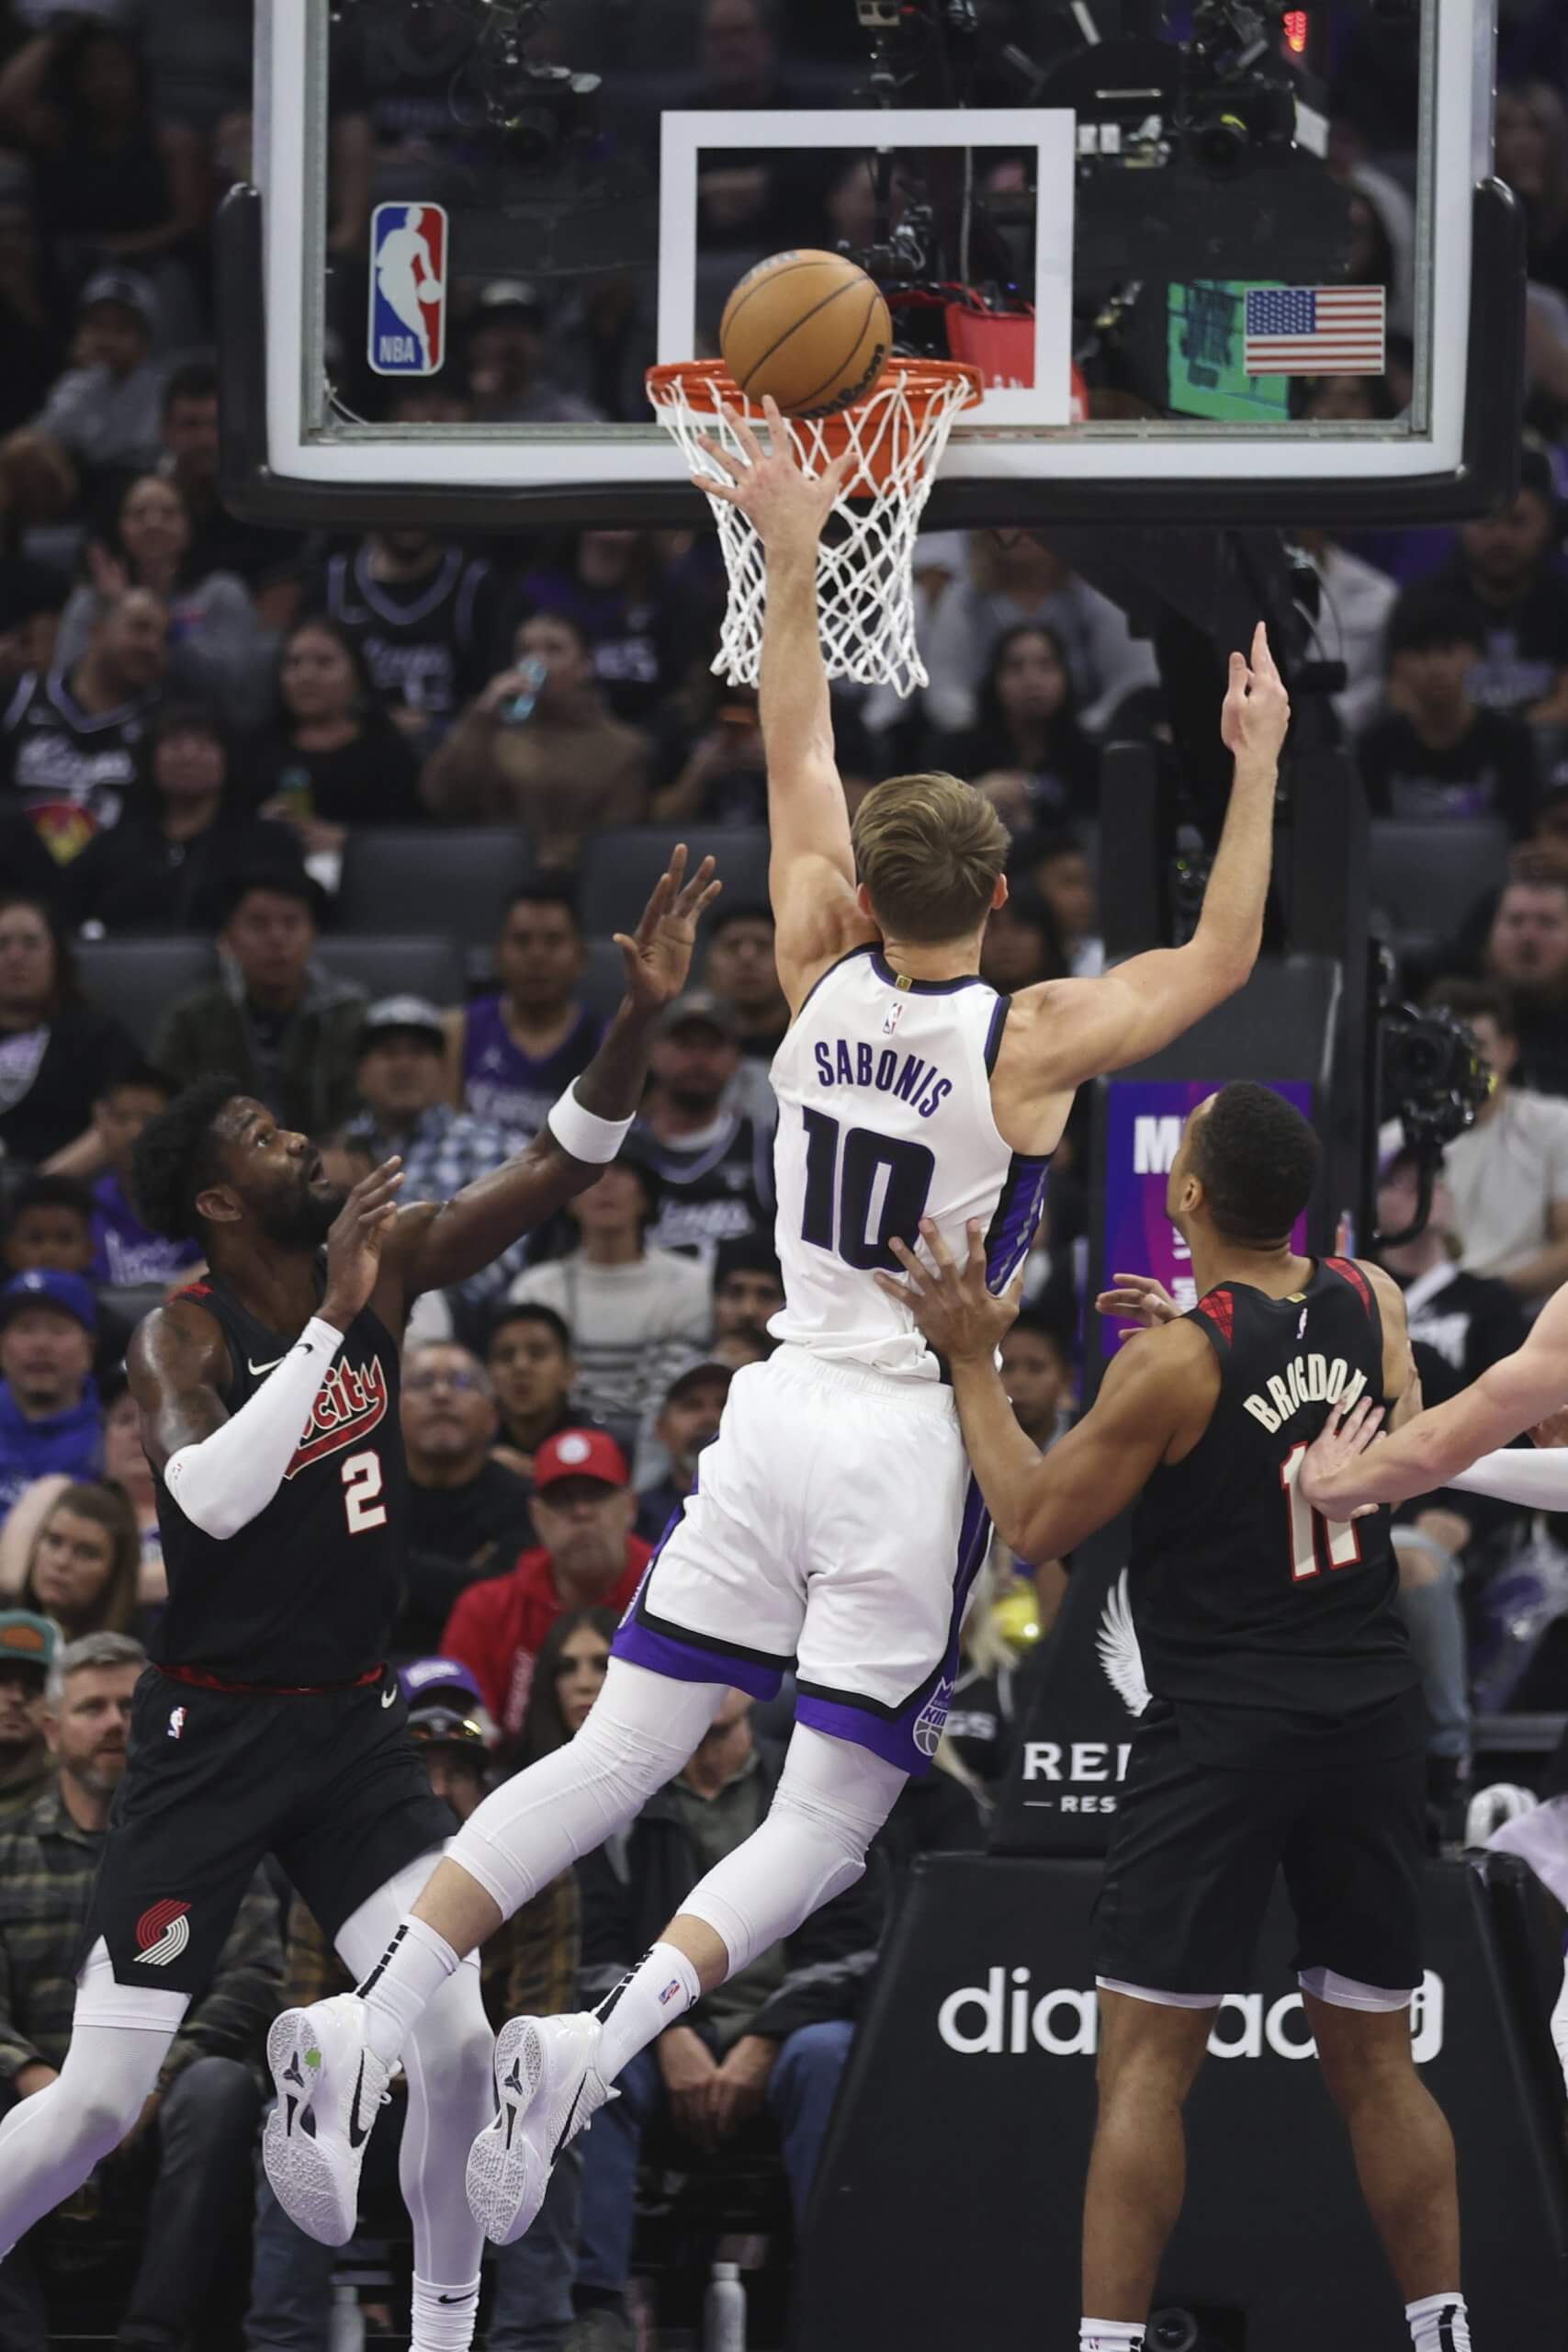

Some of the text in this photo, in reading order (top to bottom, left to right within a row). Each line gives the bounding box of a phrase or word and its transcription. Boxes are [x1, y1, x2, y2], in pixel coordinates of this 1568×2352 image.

[379, 335, 415, 363] NBA
[815, 1039, 953, 1118] SABONIS
[801, 1104, 936, 1273] 10
[341, 1449, 389, 1535] 2
